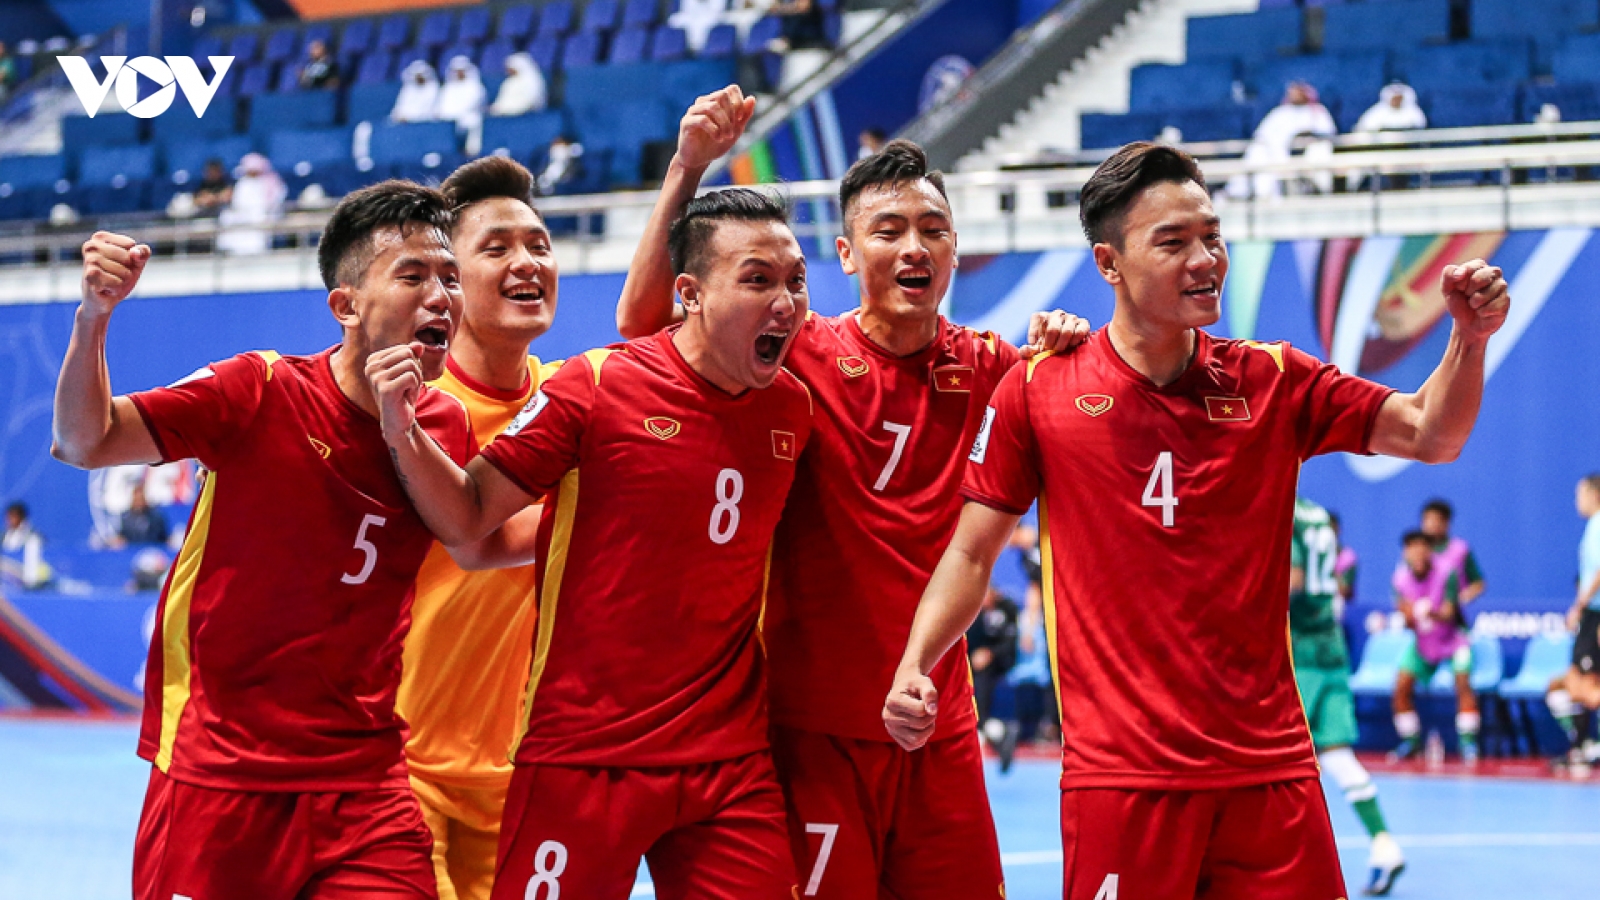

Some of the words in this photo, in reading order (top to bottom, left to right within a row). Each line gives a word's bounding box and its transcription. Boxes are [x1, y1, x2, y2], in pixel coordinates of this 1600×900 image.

[873, 421, 912, 491] 7
[1141, 451, 1179, 527] 4
[708, 468, 744, 544] 8
[340, 513, 387, 585] 5
[1303, 526, 1338, 595] 12
[524, 839, 568, 900] 8
[804, 822, 839, 896] 7
